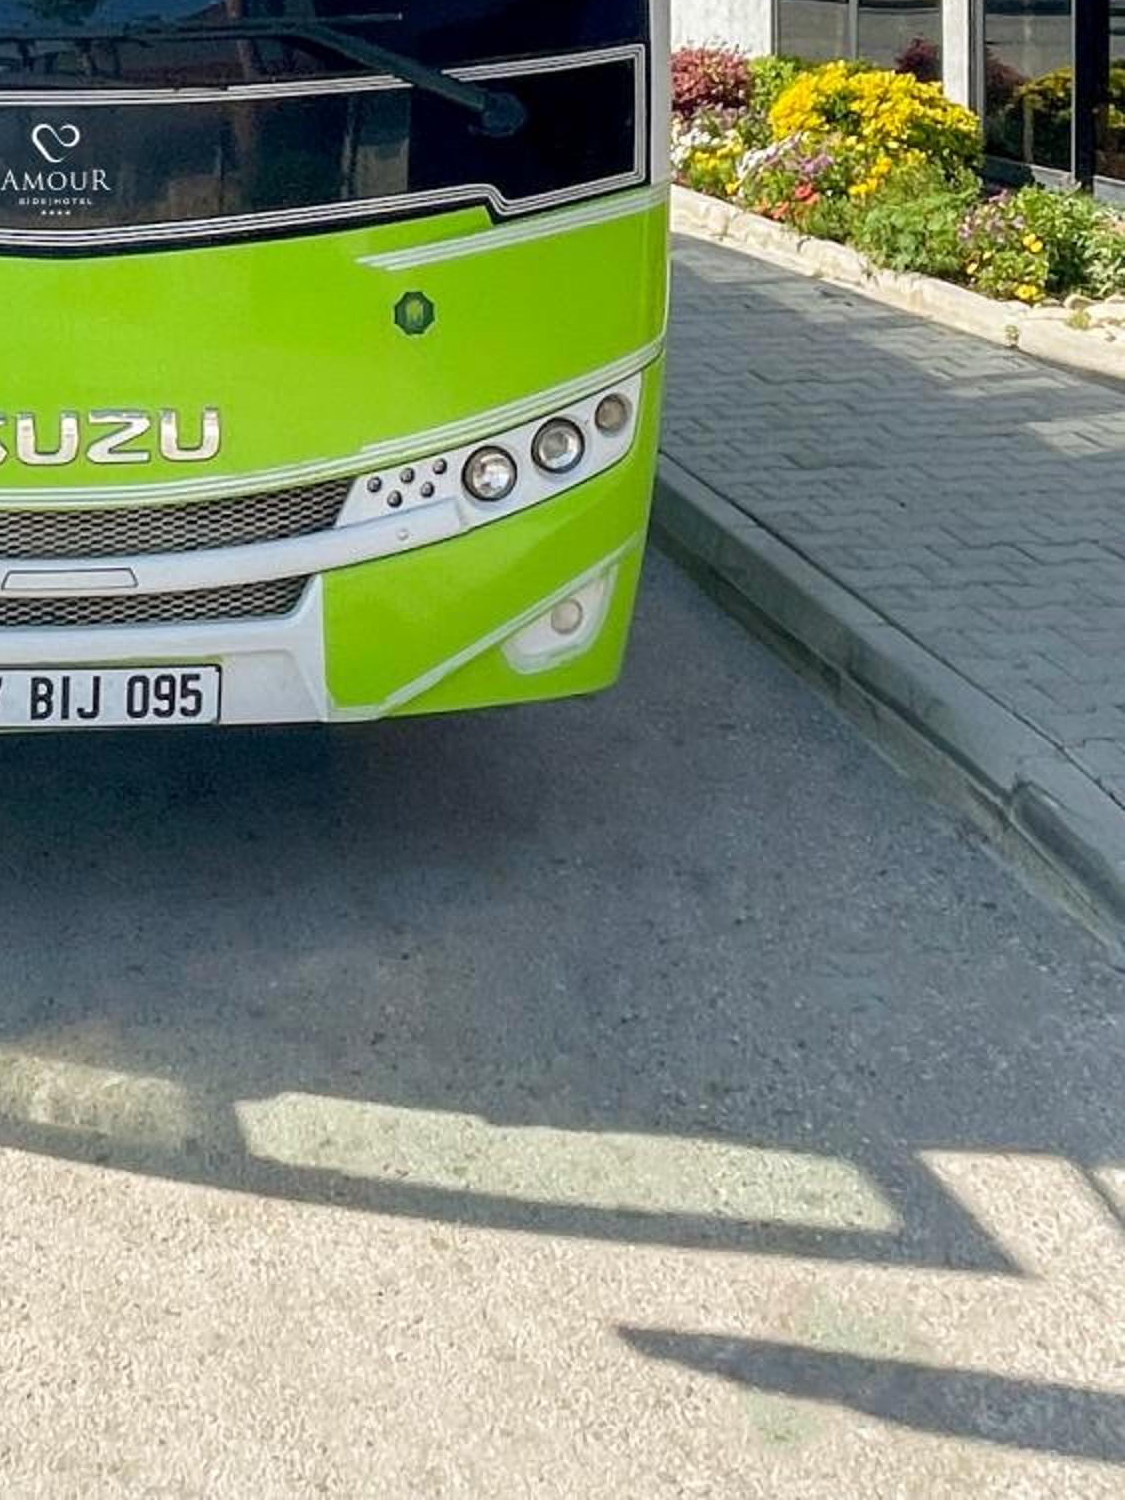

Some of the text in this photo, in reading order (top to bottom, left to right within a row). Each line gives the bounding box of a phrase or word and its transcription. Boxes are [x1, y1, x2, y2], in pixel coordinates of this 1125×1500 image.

[0, 169, 111, 191] AMOUR
[30, 676, 101, 719] BIJ
[126, 674, 202, 719] 095
